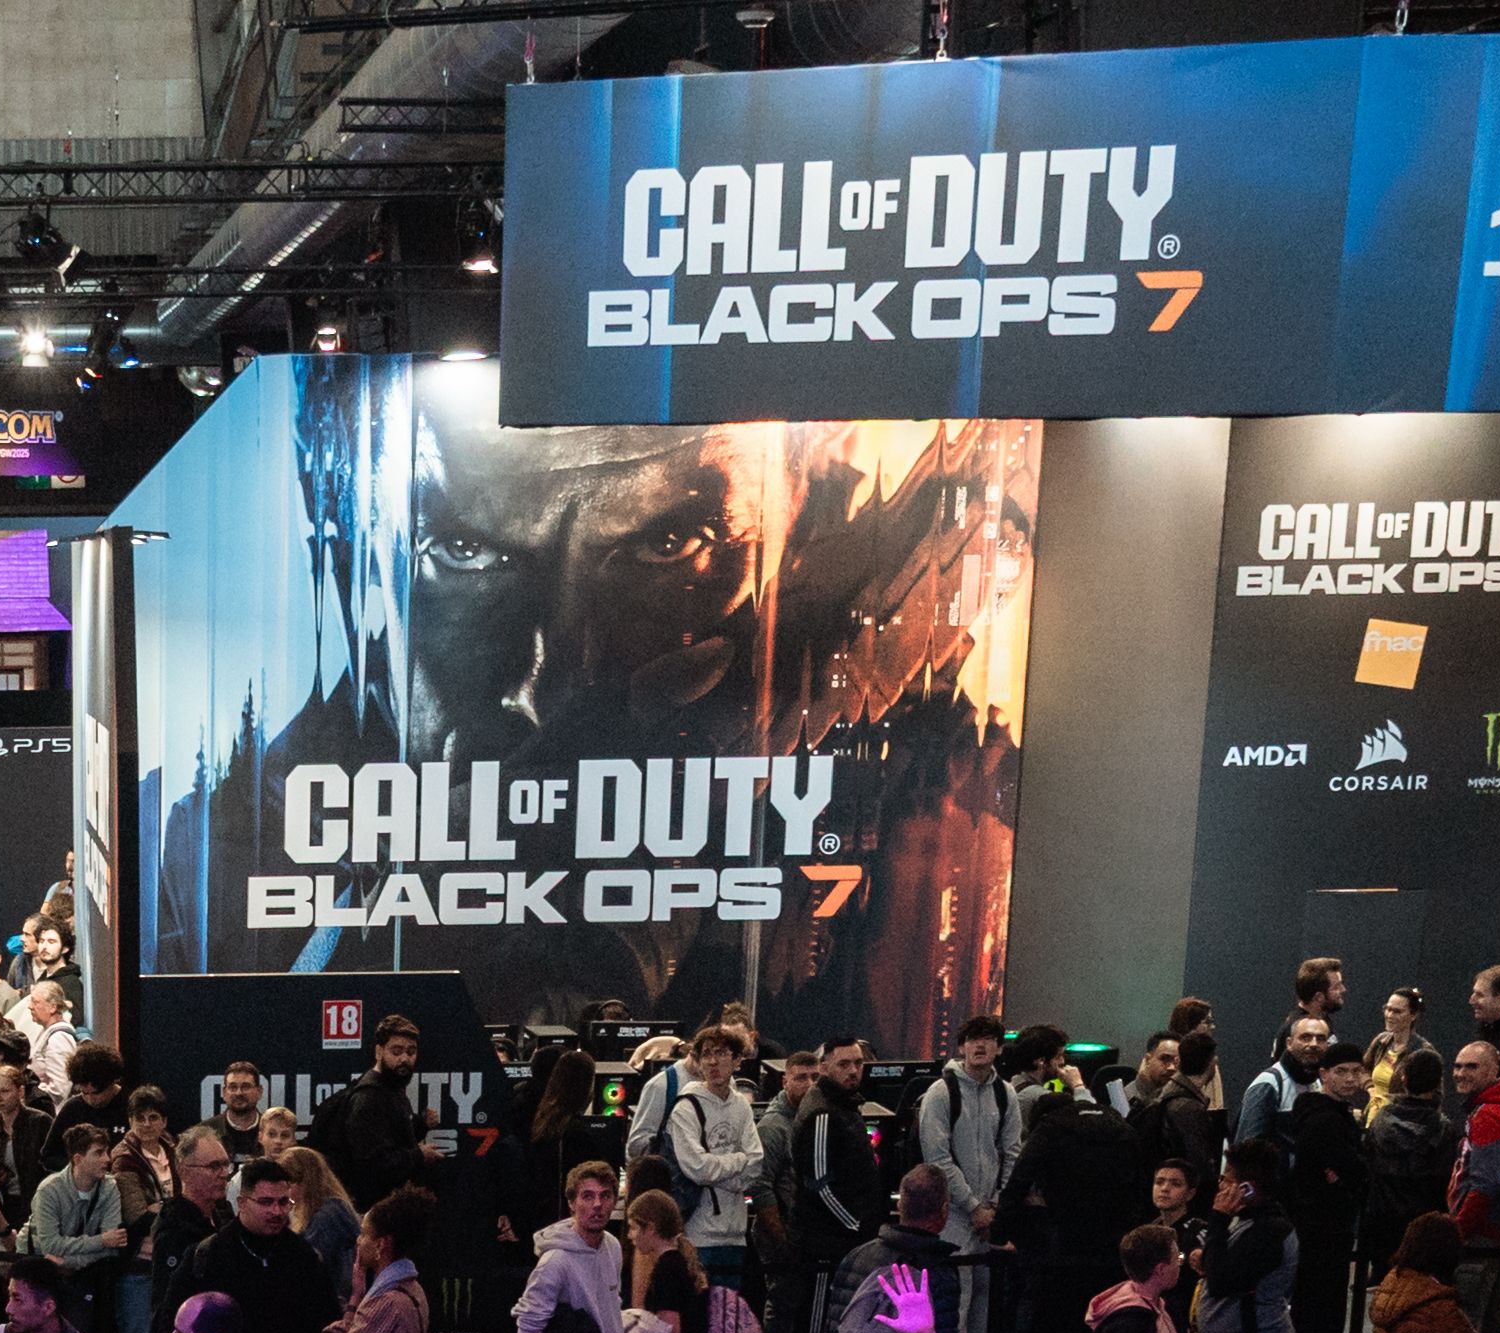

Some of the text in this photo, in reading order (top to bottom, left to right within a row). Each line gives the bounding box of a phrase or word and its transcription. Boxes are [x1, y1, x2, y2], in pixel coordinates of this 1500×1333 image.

[623, 144, 1177, 279] CALL OF DUTY
[587, 270, 1203, 348] BLACK OPS 7
[1258, 503, 1380, 560] CALL
[1377, 513, 1410, 539] OF
[1236, 563, 1407, 597] BLACK
[1363, 630, 1425, 653] fnac
[13, 738, 71, 753] PS5
[1222, 744, 1285, 767] AMD
[1329, 775, 1428, 792] CORSAIR
[284, 755, 834, 865] CALL OF DUTY
[248, 865, 862, 928] BLACK OPS 7
[326, 1005, 360, 1036] 18
[467, 1127, 500, 1158] 7
